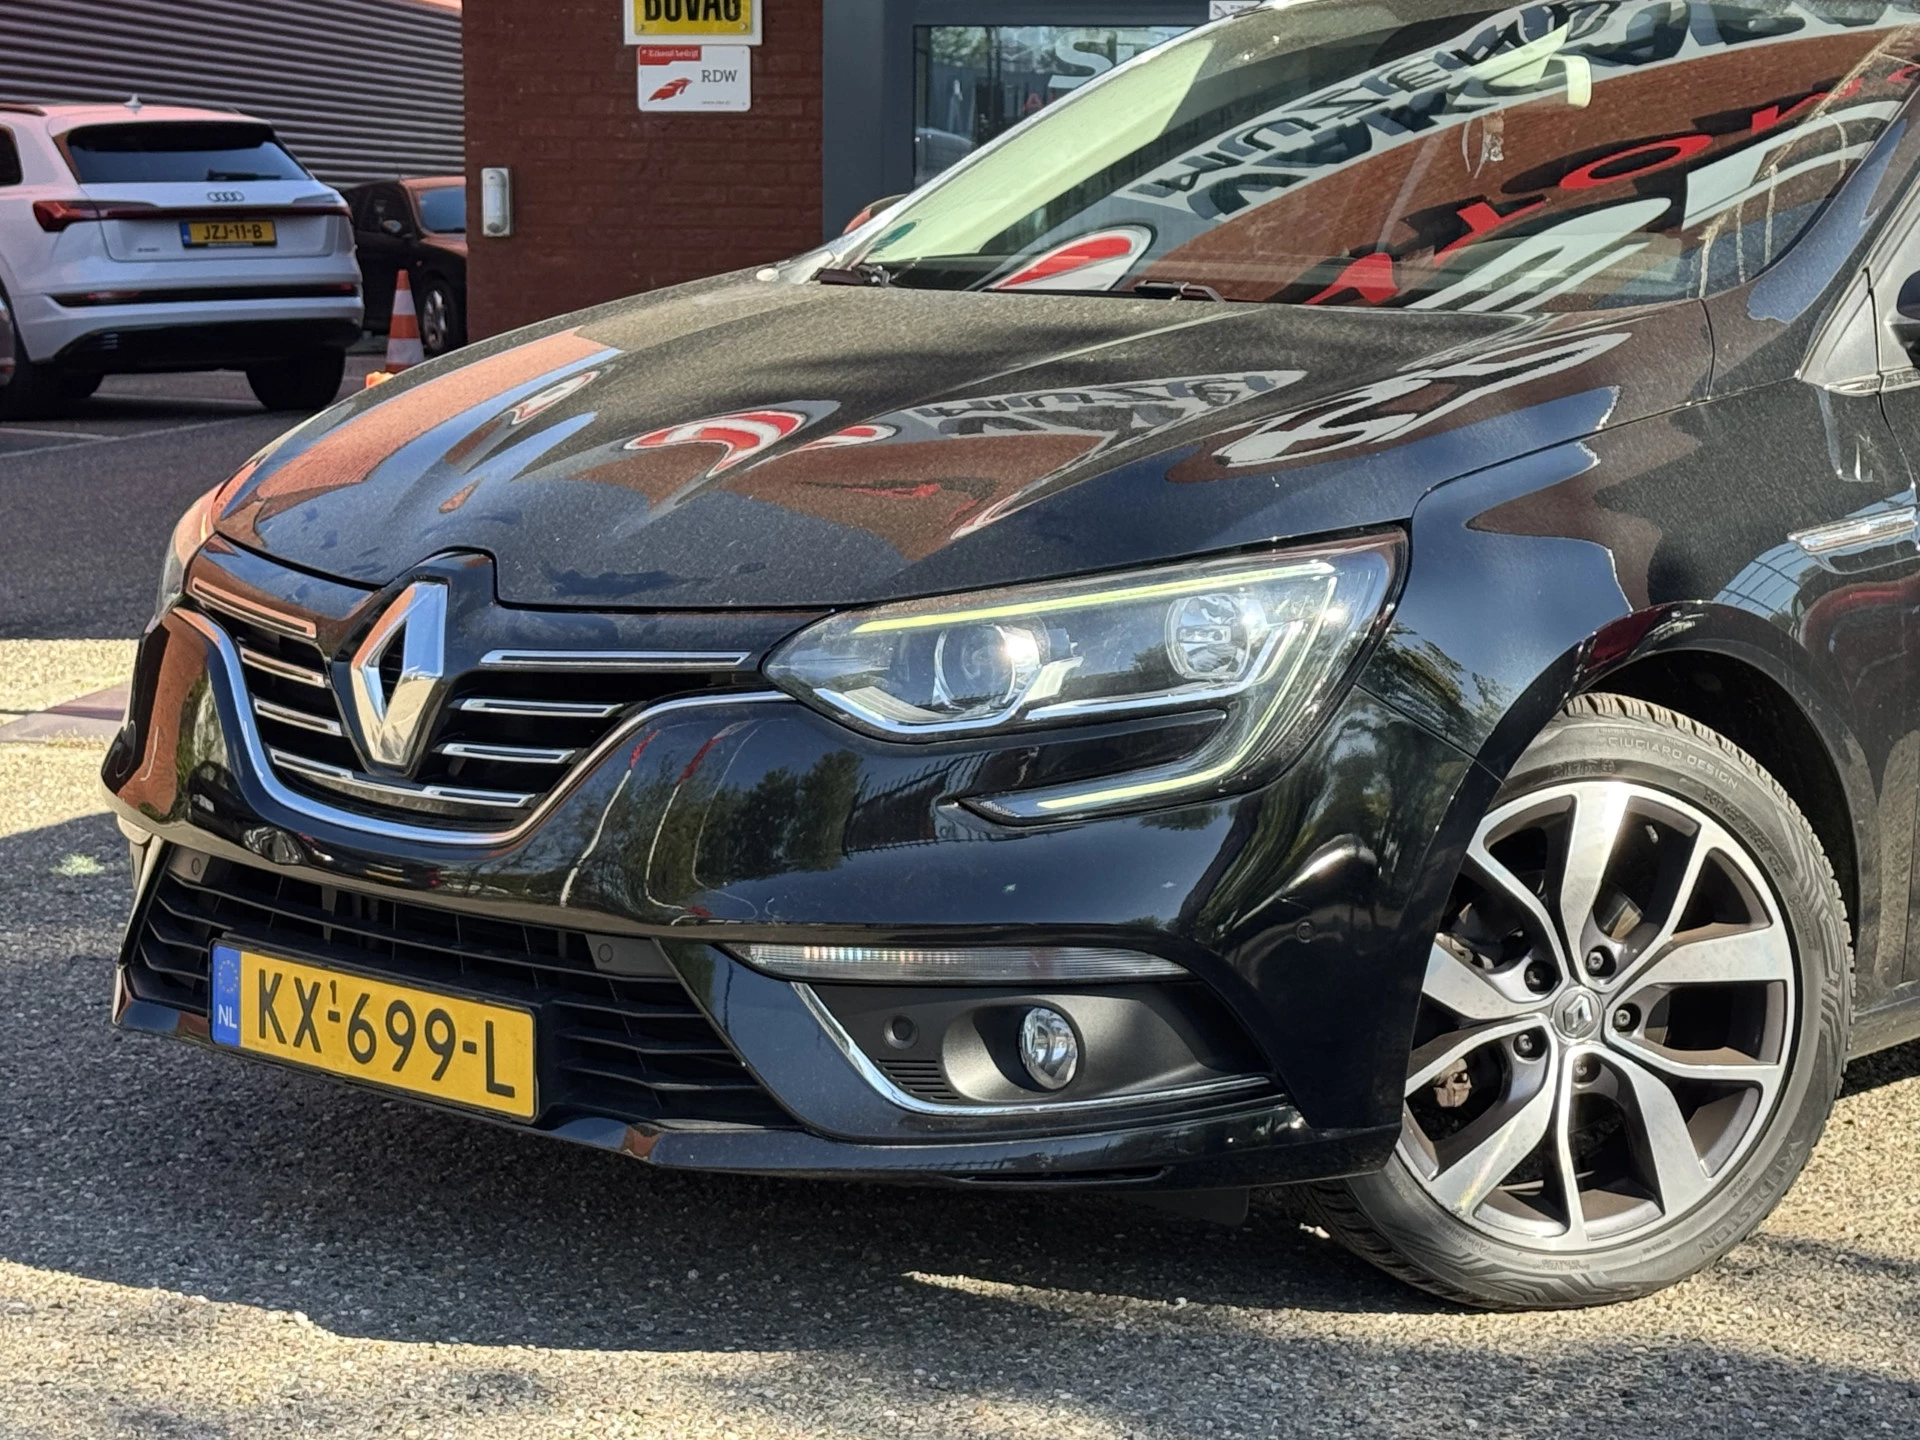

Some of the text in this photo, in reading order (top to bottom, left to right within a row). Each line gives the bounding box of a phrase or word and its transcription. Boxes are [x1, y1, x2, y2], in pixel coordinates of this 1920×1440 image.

[701, 69, 738, 83] RDW
[204, 223, 263, 240] JZJ-11-B
[1686, 754, 1739, 790] DESIGN
[218, 1003, 237, 1030] NL
